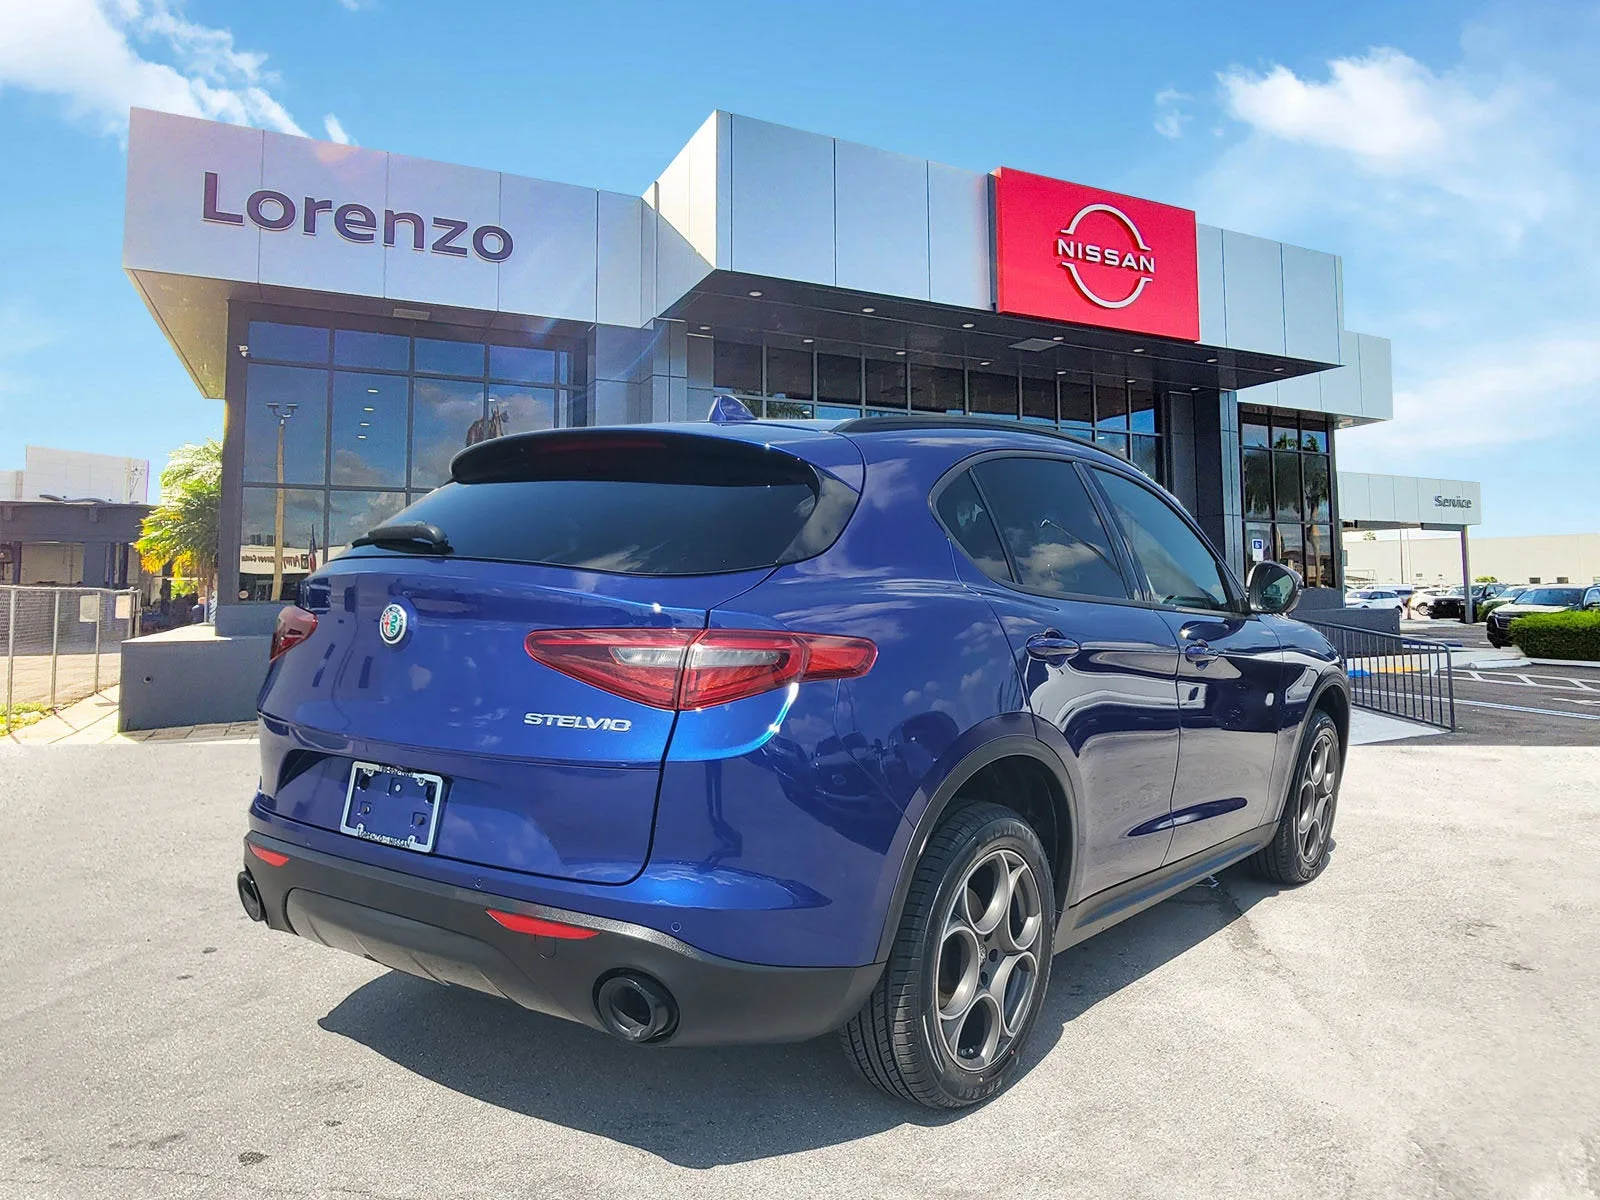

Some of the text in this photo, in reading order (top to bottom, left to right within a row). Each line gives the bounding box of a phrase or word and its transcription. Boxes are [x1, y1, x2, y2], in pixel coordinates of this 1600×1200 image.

[202, 171, 514, 262] Lorenzo
[1057, 238, 1155, 273] NISSAN
[1434, 495, 1472, 508] Service
[523, 712, 632, 732] STELVIO
